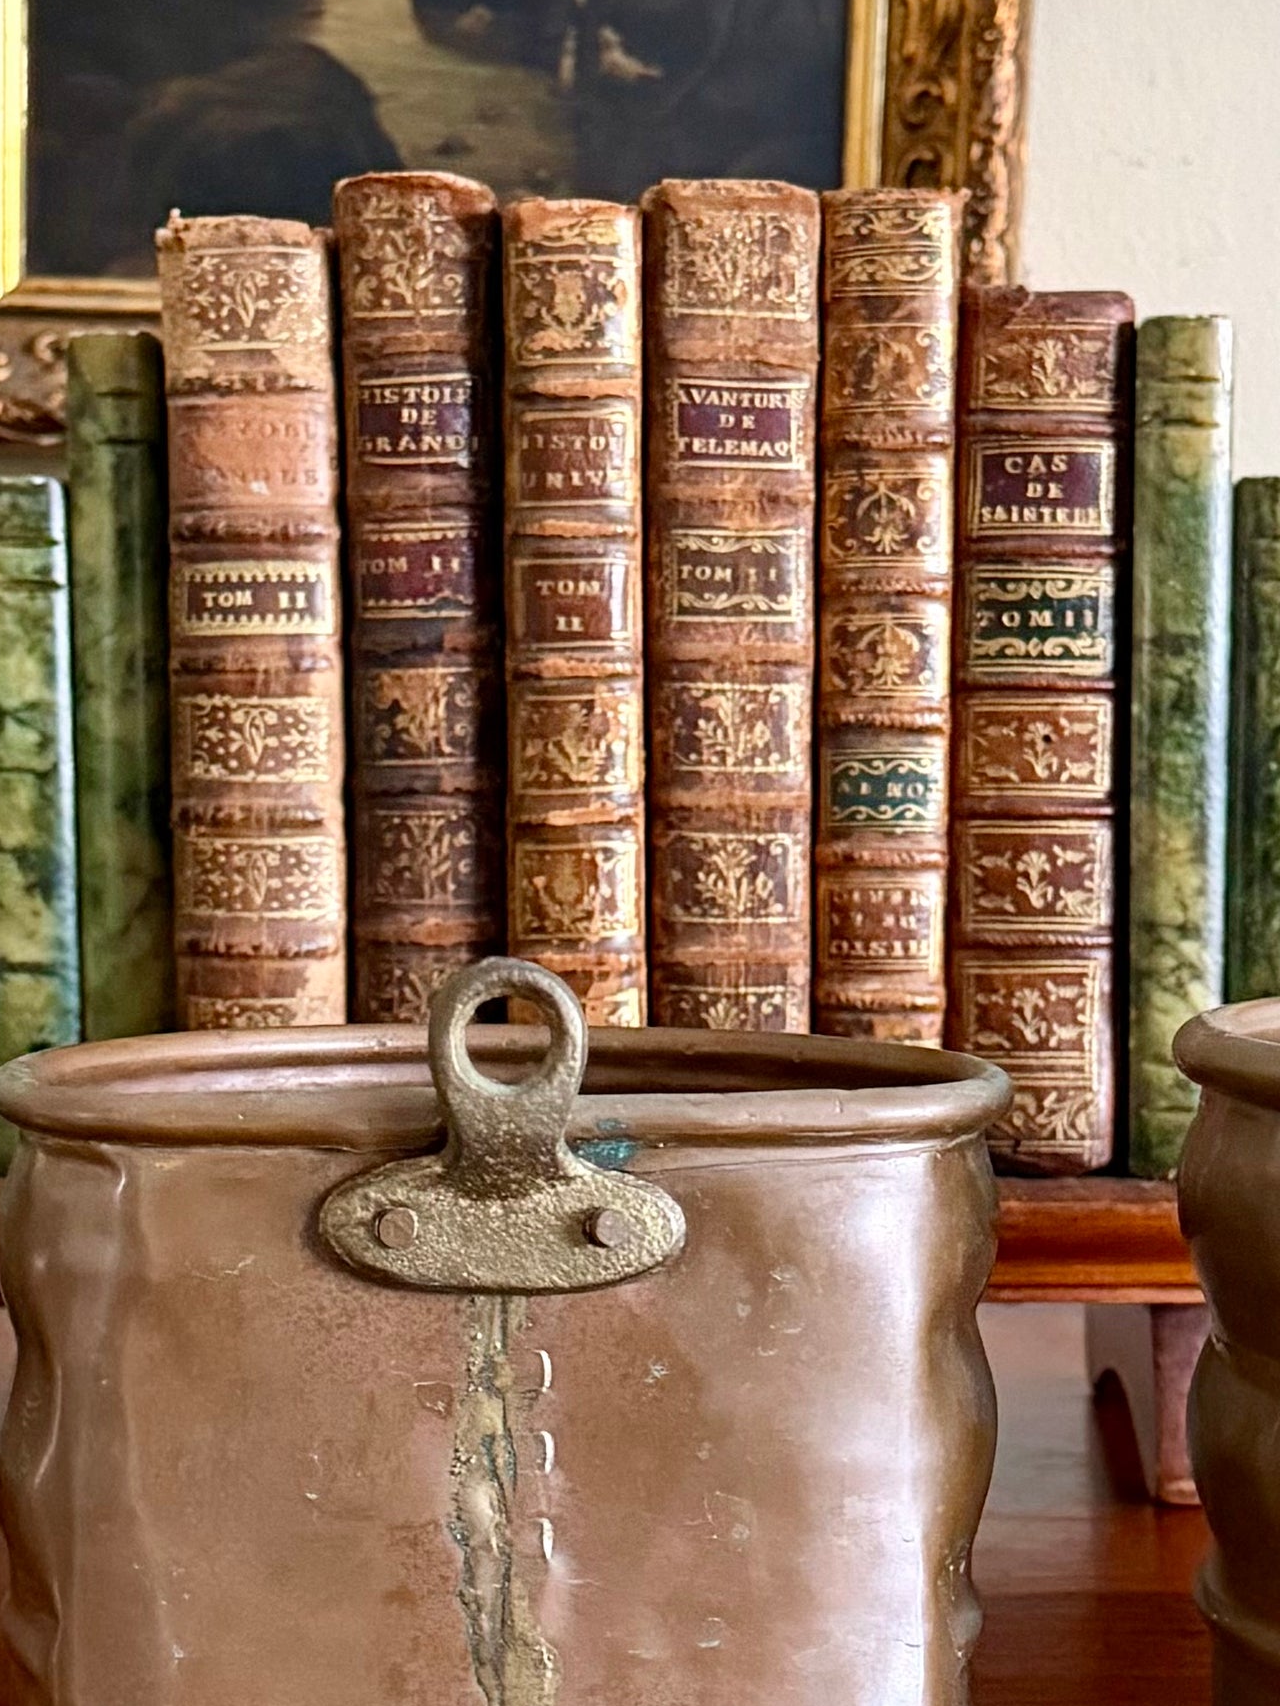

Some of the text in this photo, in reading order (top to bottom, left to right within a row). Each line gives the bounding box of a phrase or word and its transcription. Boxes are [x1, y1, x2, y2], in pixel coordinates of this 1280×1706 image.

[400, 407, 438, 426] DE
[718, 413, 757, 430] DE
[1004, 454, 1069, 474] CAS
[1026, 481, 1064, 499] DE
[361, 556, 408, 573] TOM
[680, 563, 733, 583] TOM
[203, 590, 309, 610] TOM II
[555, 615, 585, 633] II
